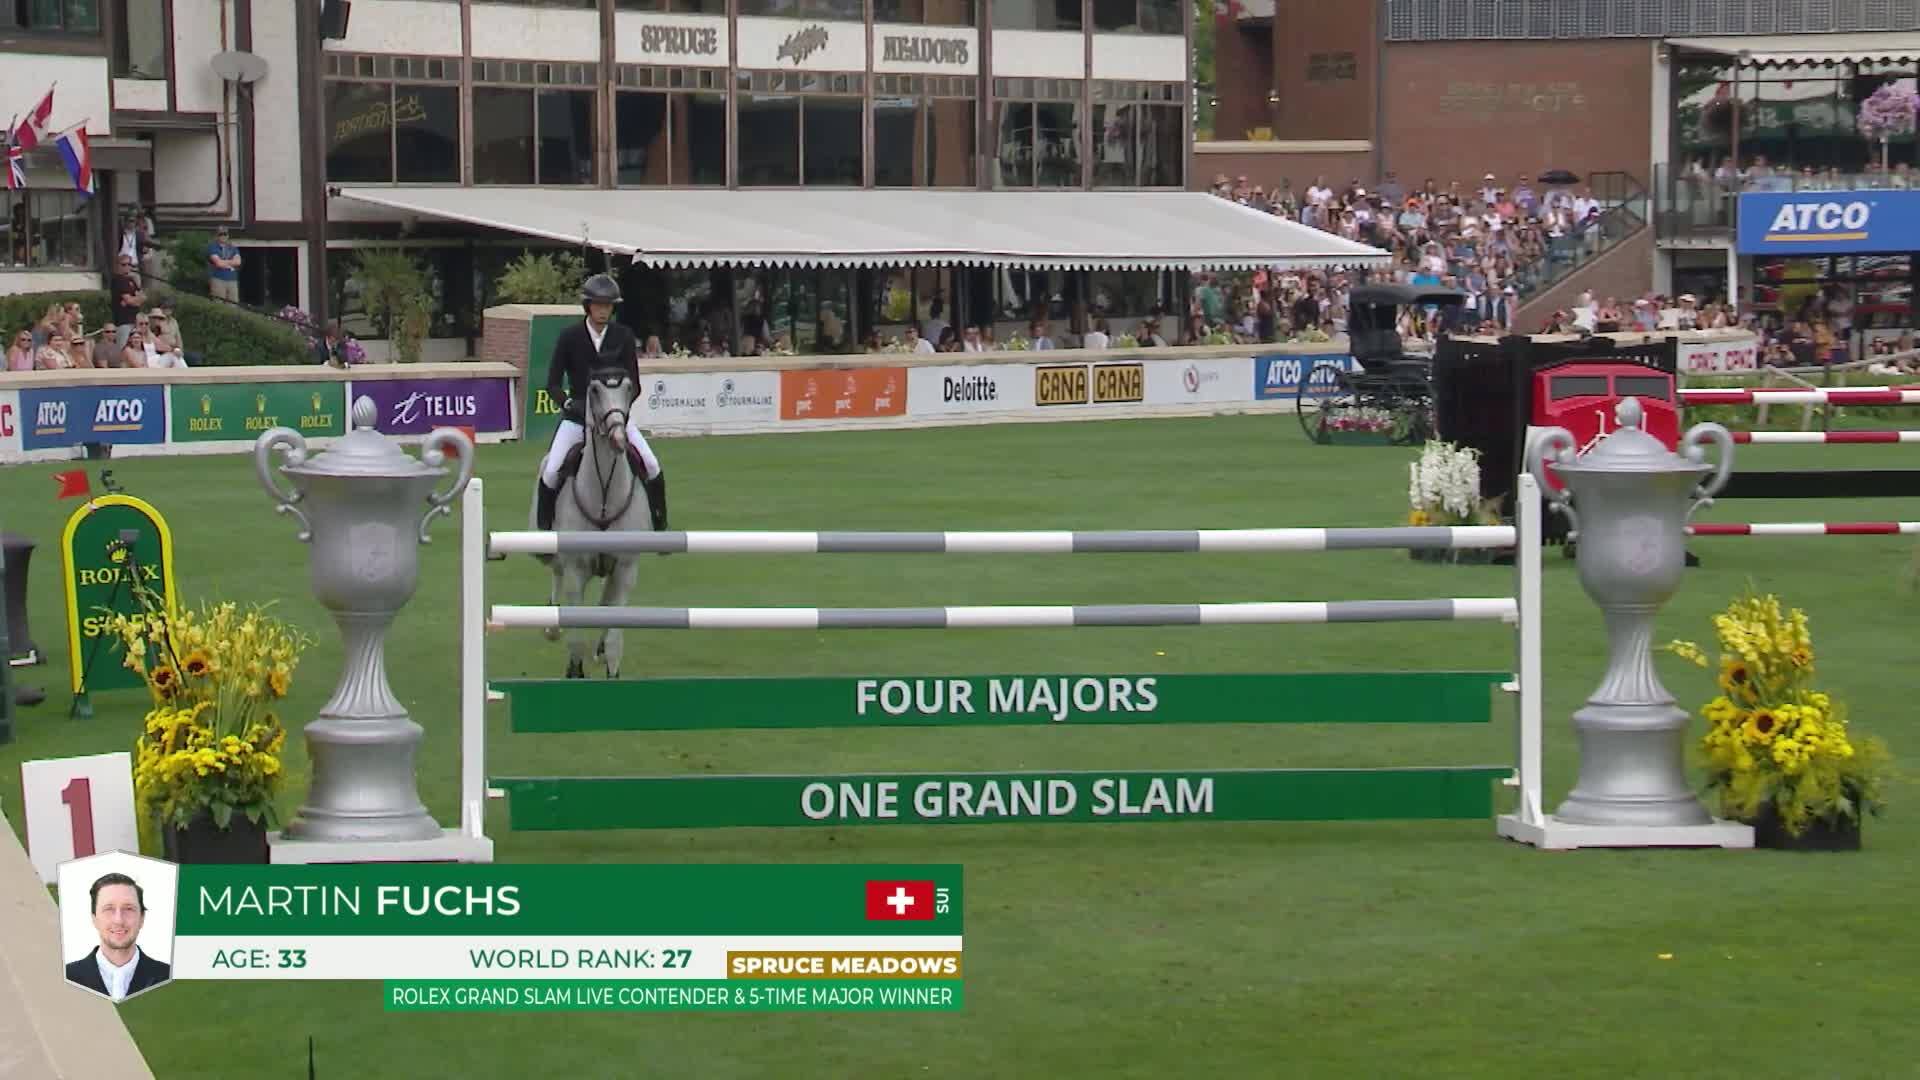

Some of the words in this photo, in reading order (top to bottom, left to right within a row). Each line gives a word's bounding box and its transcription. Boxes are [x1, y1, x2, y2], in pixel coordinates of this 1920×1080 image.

[641, 24, 717, 55] SPRUCE
[884, 36, 968, 64] MEADOWS
[1769, 201, 1869, 231] ATCO
[1040, 371, 1086, 401] CANA
[1097, 368, 1141, 399] CANA
[1267, 360, 1302, 385] ATCO
[37, 401, 67, 426] ATCO
[95, 399, 144, 423] ATCO
[425, 395, 476, 416] TELUS
[189, 417, 223, 432] ROLEX
[245, 416, 279, 430] ROLEX
[301, 414, 333, 428] ROLEX
[857, 679, 976, 715] FOUR
[989, 677, 1158, 722] MAJORS
[801, 782, 899, 820] ONE
[913, 779, 1078, 818] GRAND
[1091, 778, 1214, 815] SLAM
[61, 777, 97, 859] 1
